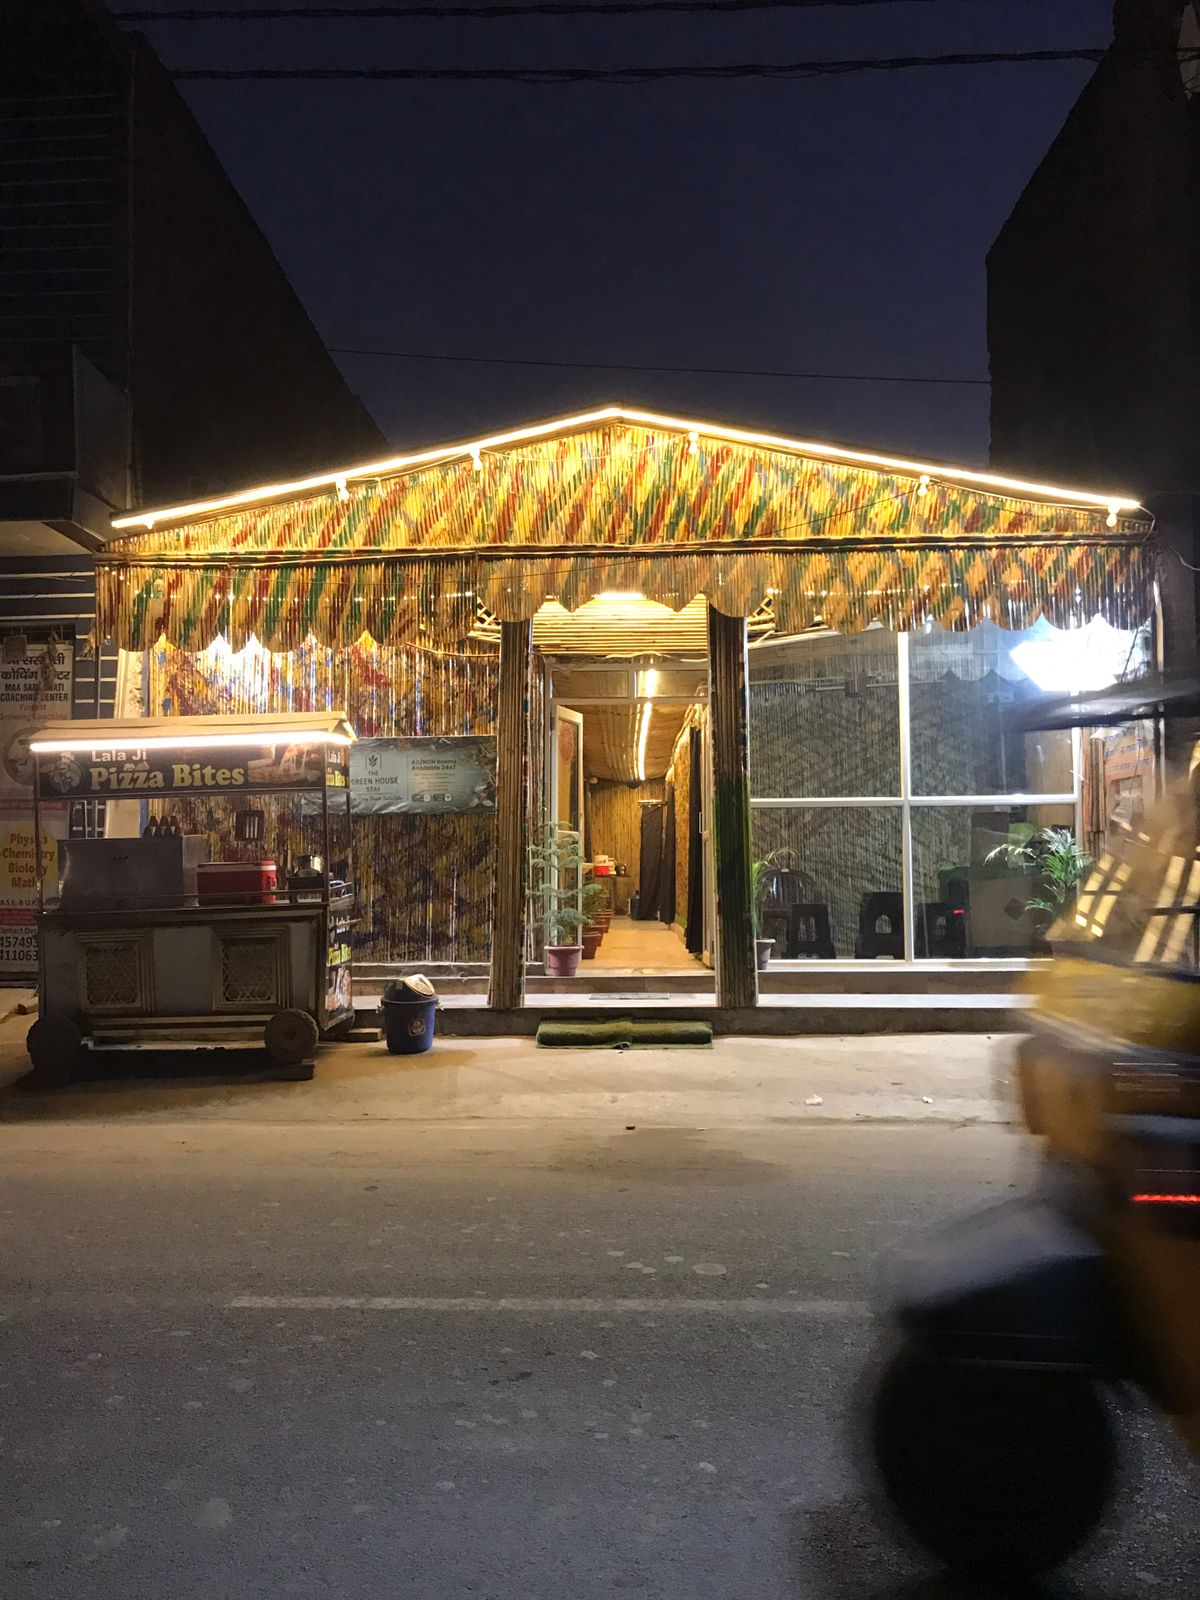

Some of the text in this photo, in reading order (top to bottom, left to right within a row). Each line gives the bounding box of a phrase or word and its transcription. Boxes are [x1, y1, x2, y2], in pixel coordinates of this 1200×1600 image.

[1, 668, 38, 680] कोचिंग
[5, 683, 20, 692] MAA
[91, 747, 147, 762] Lala Ji
[89, 763, 245, 790] Pizza Bites
[375, 777, 399, 785] HOUSE
[8, 862, 48, 875] Bioloy
